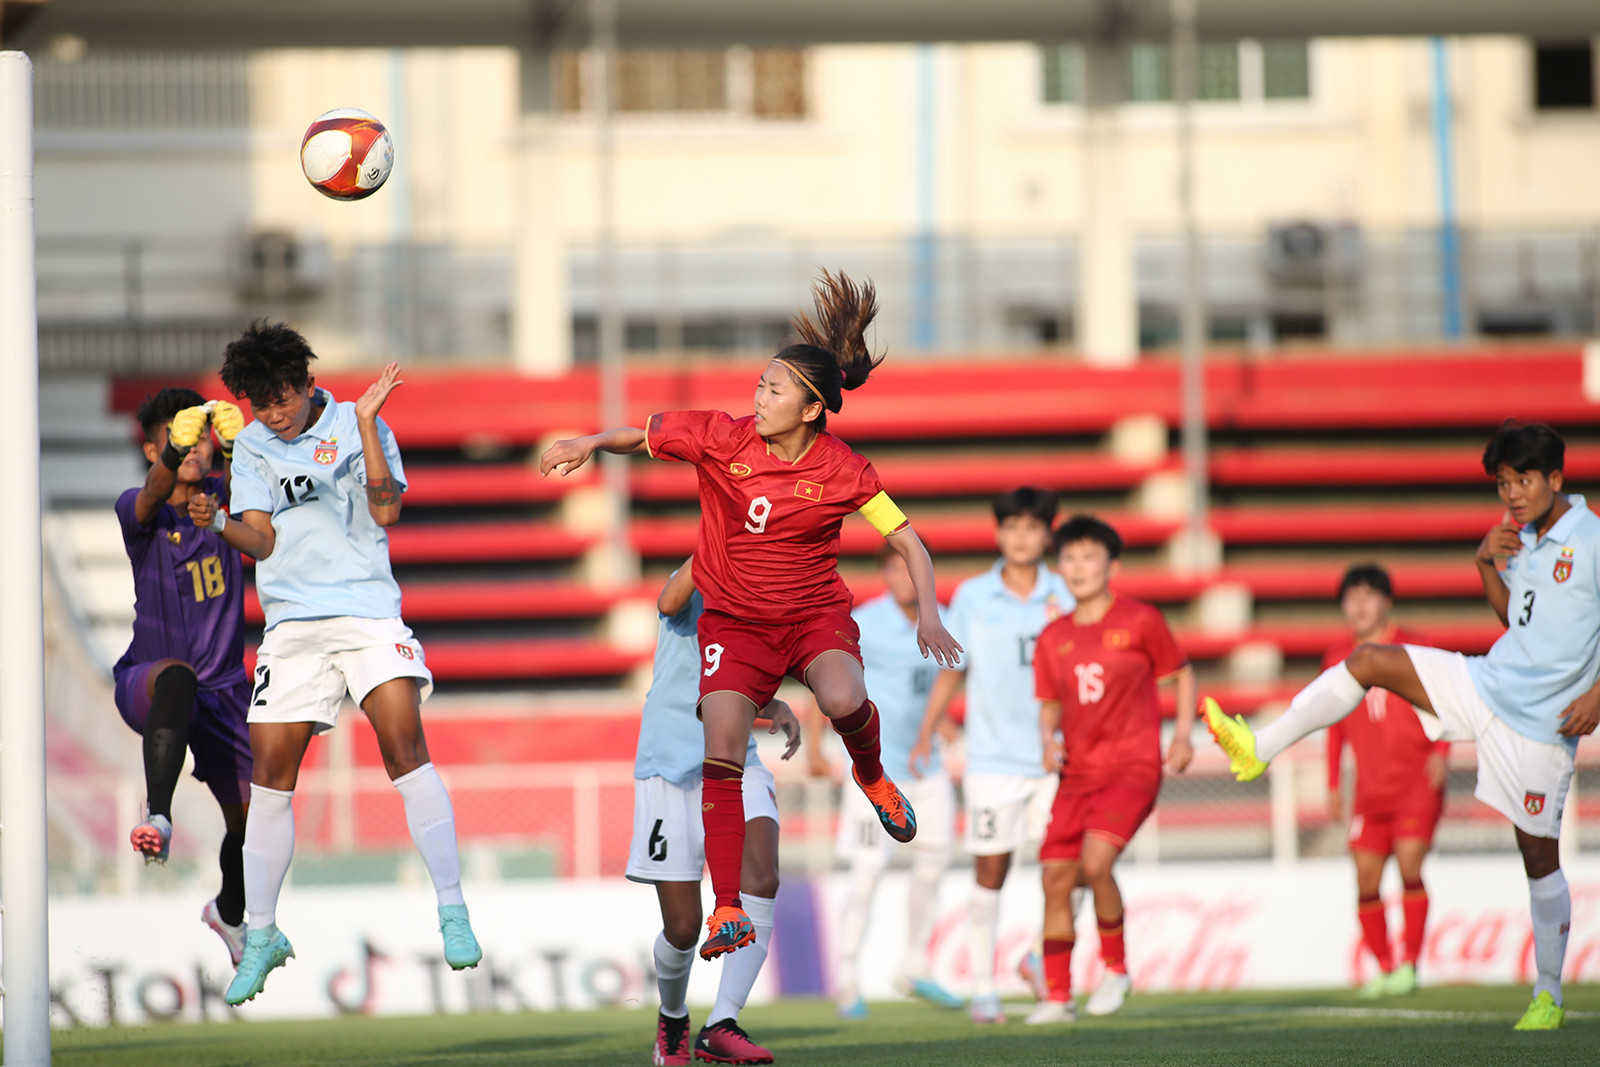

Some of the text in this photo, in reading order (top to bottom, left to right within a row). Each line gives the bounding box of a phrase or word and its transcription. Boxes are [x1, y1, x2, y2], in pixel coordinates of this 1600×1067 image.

[280, 475, 319, 505] 12
[745, 496, 772, 533] 9
[186, 555, 226, 603] 18
[1518, 590, 1536, 627] 3
[704, 643, 725, 677] 9
[1074, 661, 1105, 706] 15
[648, 818, 668, 862] 6
